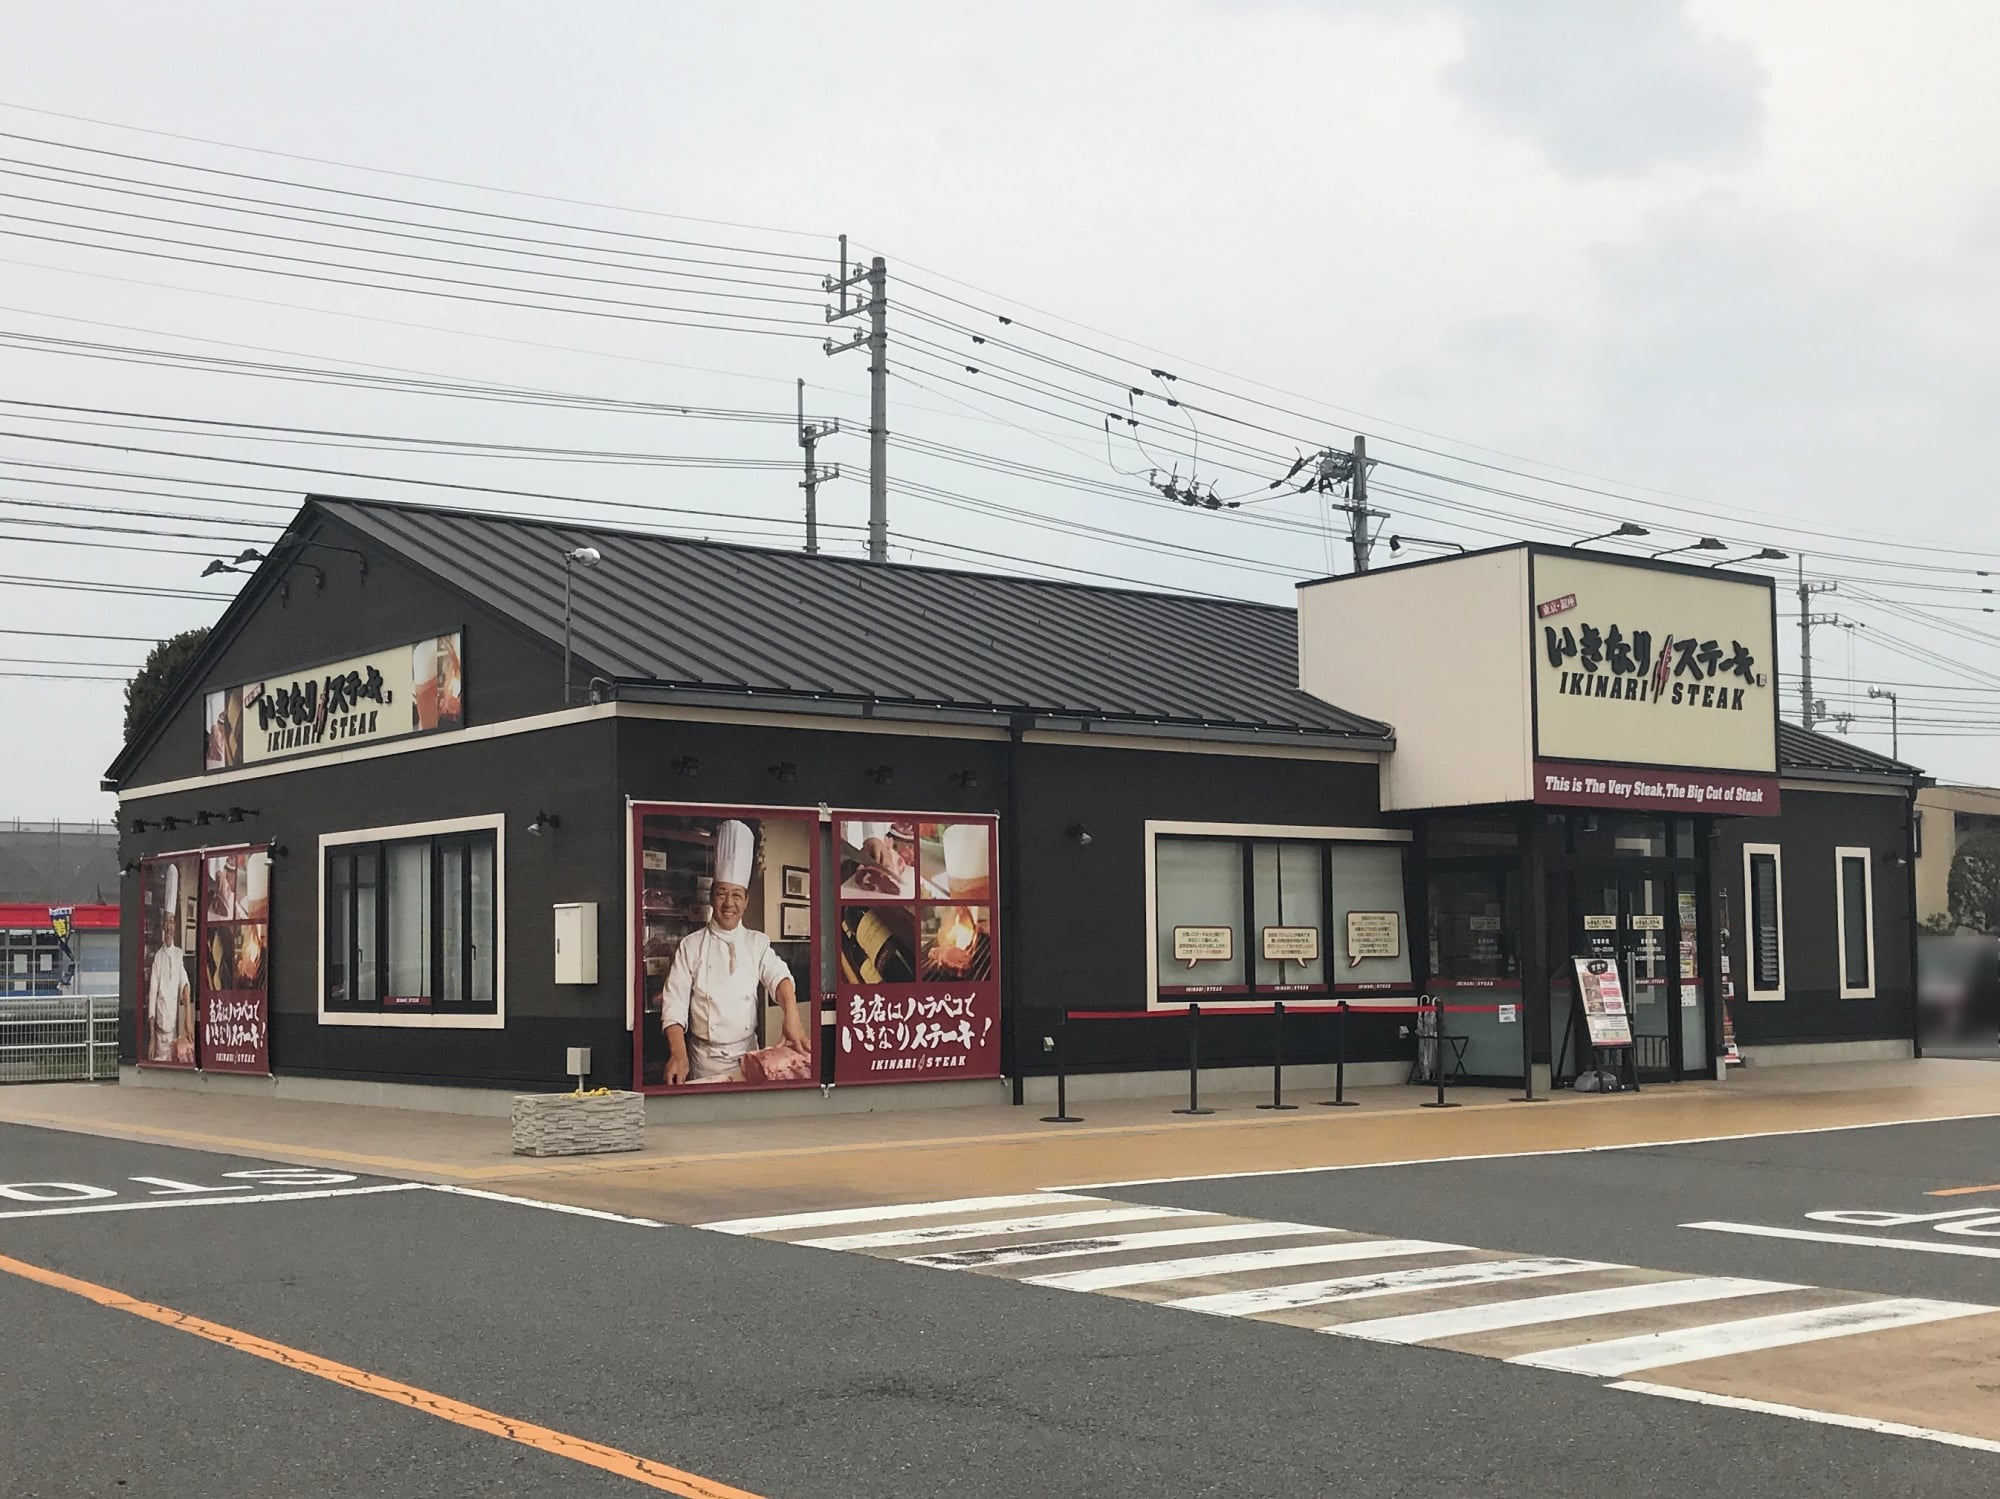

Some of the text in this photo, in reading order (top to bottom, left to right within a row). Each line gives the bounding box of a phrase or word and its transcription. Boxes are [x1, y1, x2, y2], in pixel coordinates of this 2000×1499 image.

[1545, 623, 1755, 684] いきなり ステーキ
[1559, 671, 1745, 711] IKINARI STEAK
[267, 710, 378, 752] IKINARI STEAK
[1545, 775, 1570, 791] This
[1571, 777, 1583, 792] is
[1584, 777, 1606, 793] The
[1608, 779, 1632, 798] Very
[1687, 784, 1704, 803] Big
[1706, 785, 1722, 801] Cut
[1724, 786, 1735, 801] of
[1736, 787, 1764, 803] Steak
[871, 1055, 967, 1071] IKINARI STEAK
